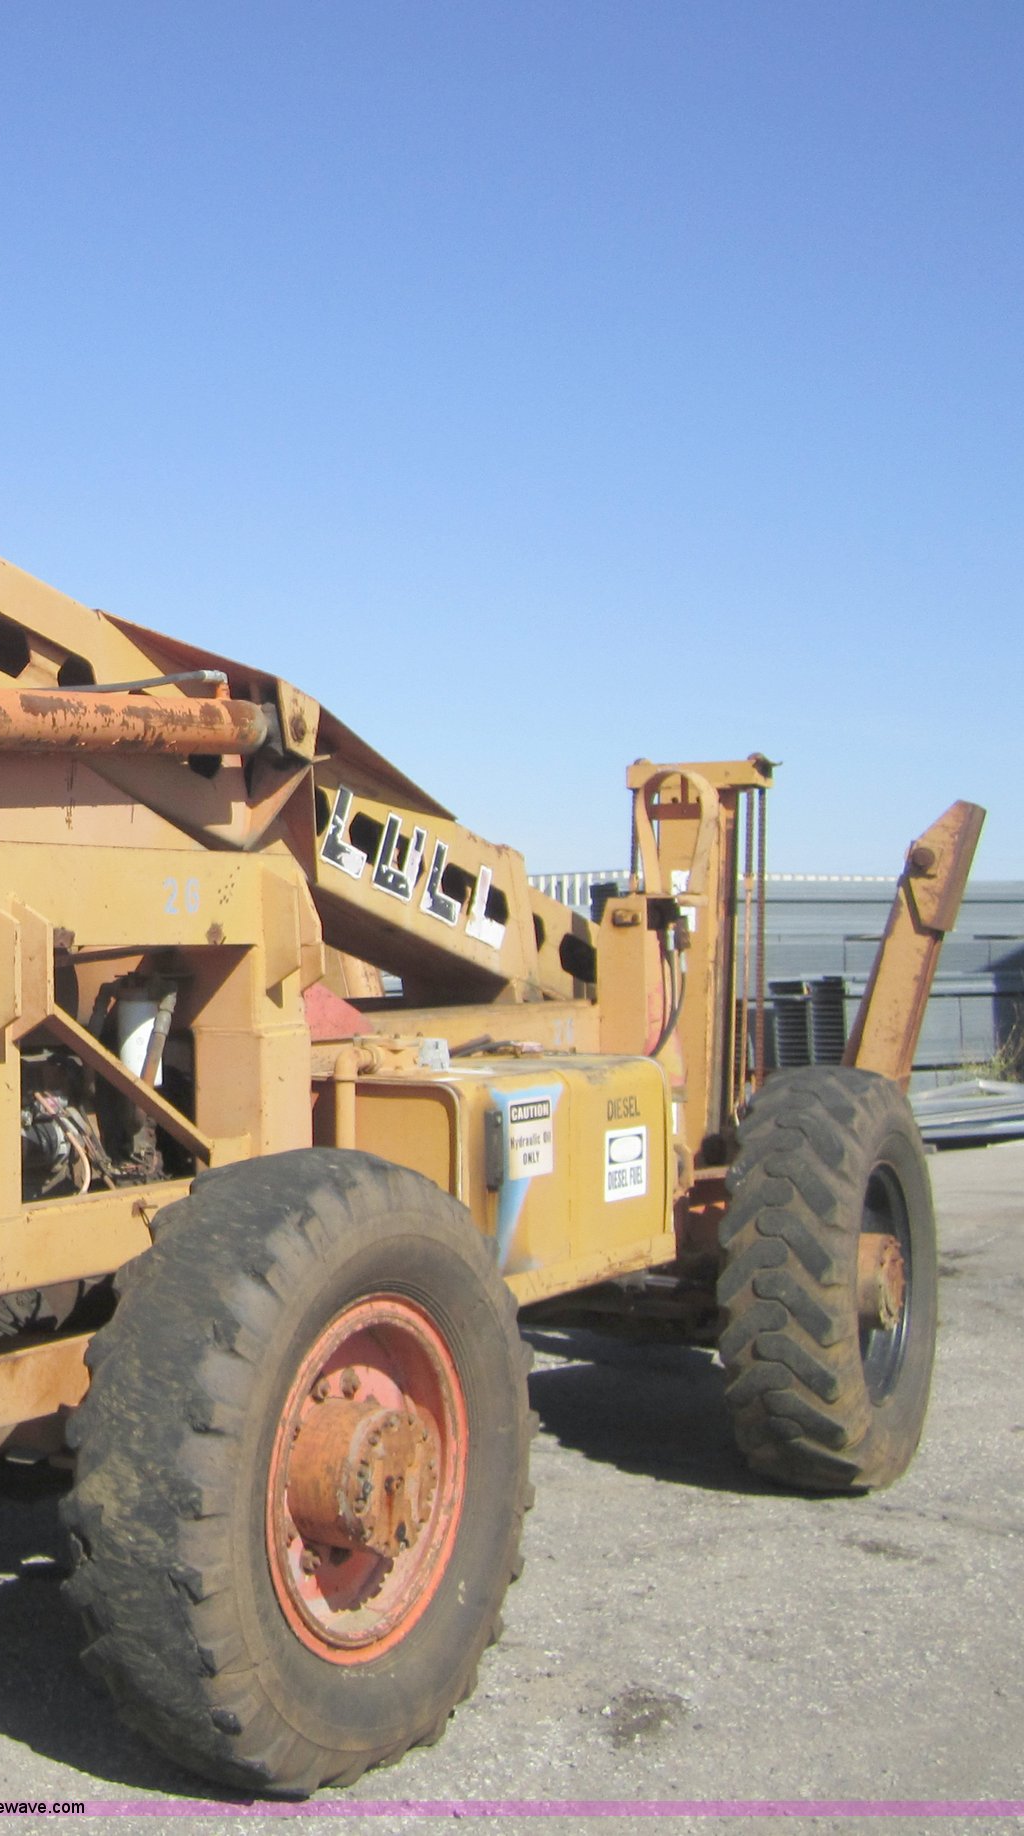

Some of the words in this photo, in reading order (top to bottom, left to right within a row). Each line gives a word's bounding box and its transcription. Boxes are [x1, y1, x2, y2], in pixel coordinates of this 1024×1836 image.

[320, 784, 506, 950] LULL
[511, 1102, 550, 1120] CAUTION
[607, 1096, 640, 1121] DIESEL
[510, 1134, 541, 1151] Hydraulic
[543, 1131, 551, 1142] Oil
[522, 1152, 540, 1166] ONLY
[608, 1169, 628, 1190] DIESEL
[629, 1166, 643, 1186] FUEL
